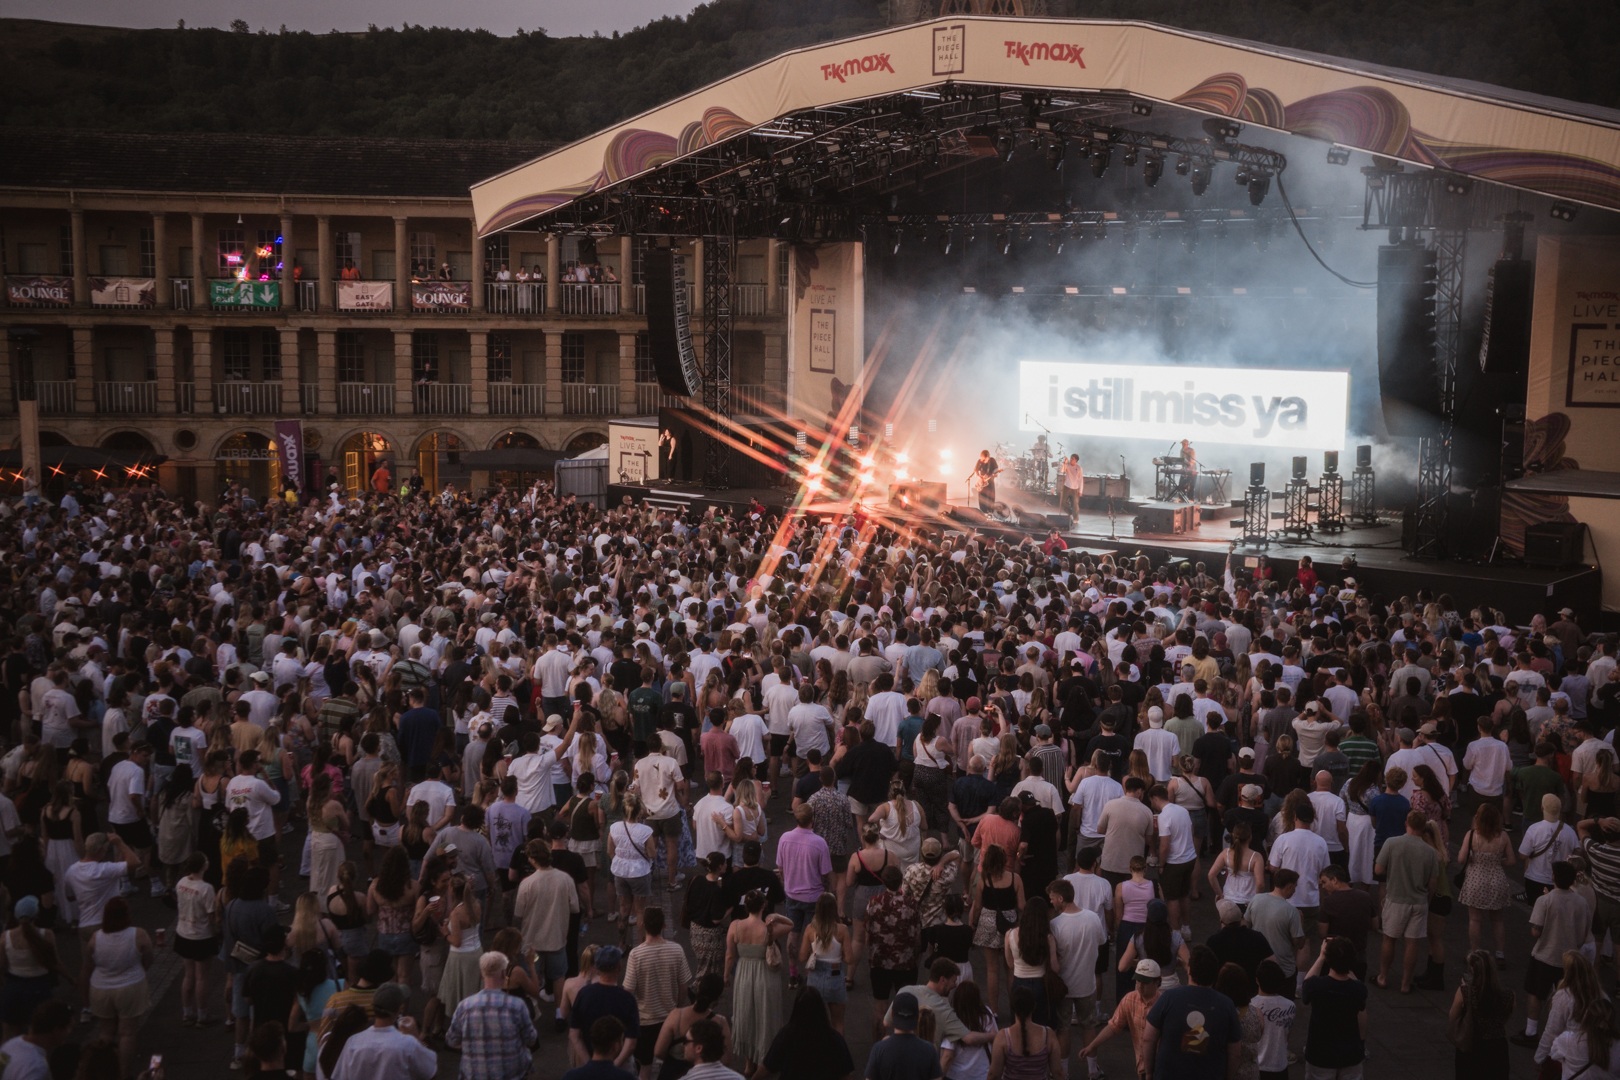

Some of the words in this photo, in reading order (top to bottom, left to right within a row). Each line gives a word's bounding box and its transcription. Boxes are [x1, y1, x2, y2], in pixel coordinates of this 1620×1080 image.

[941, 34, 957, 43] THE
[937, 43, 960, 52] PIECE
[938, 53, 959, 61] HALL
[11, 286, 68, 299] LOUNGE
[215, 285, 235, 294] Fire
[215, 295, 235, 303] exit
[415, 292, 467, 304] LOUNGE
[810, 294, 825, 304] LIVE
[826, 294, 836, 304] AT
[1573, 304, 1617, 317] LIVE
[817, 320, 829, 330] THE
[813, 332, 832, 342] PIECE
[814, 345, 830, 354] HALL
[1593, 339, 1620, 350] TH
[1582, 355, 1620, 366] PIEC
[1584, 371, 1619, 382] HAL
[1048, 374, 1059, 417] i
[1063, 376, 1134, 422] still
[1139, 380, 1247, 427] miss
[1251, 393, 1309, 438] ya
[619, 442, 635, 450] LIVE
[637, 443, 646, 451] AT
[218, 448, 271, 459] LIBRAR
